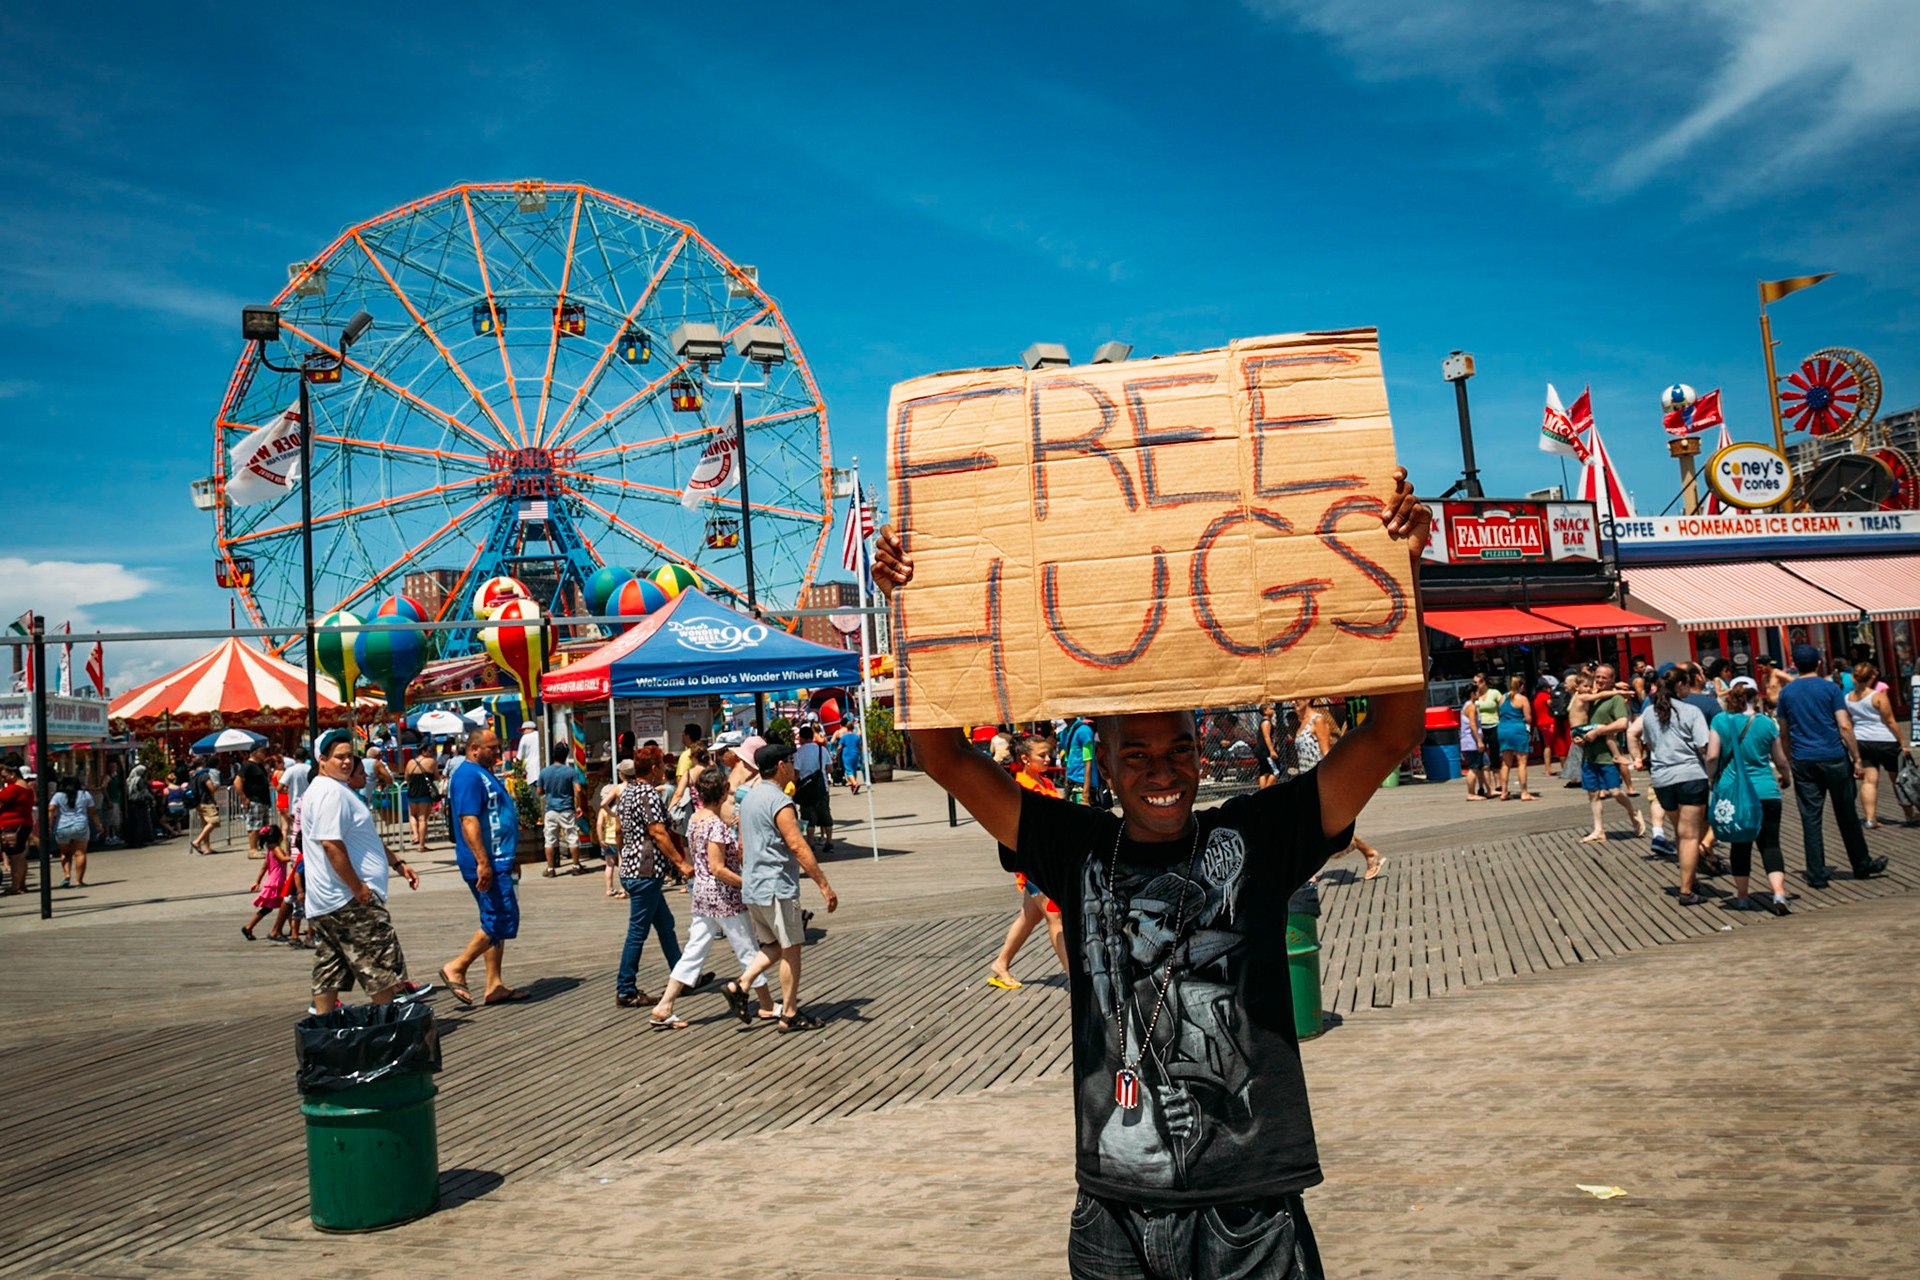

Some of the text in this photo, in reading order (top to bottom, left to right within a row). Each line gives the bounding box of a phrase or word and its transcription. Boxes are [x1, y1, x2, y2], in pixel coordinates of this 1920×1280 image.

[486, 448, 576, 471] WONDER
[895, 350, 1367, 553] FREE
[494, 474, 572, 496] WHEEL
[1744, 480, 1780, 490] cones
[1553, 518, 1589, 531] SNACK
[1602, 516, 1902, 538] COFFEE HOMEMADE ICE CREAM TREATS
[1456, 525, 1539, 548] FAMIGLIA
[1563, 532, 1584, 545] BAR
[894, 495, 1408, 724] HUGS
[679, 628, 721, 637] WONDER
[688, 634, 720, 642] WHEEL
[636, 668, 839, 687] Welcome to Deno's Wonder Wheel Park
